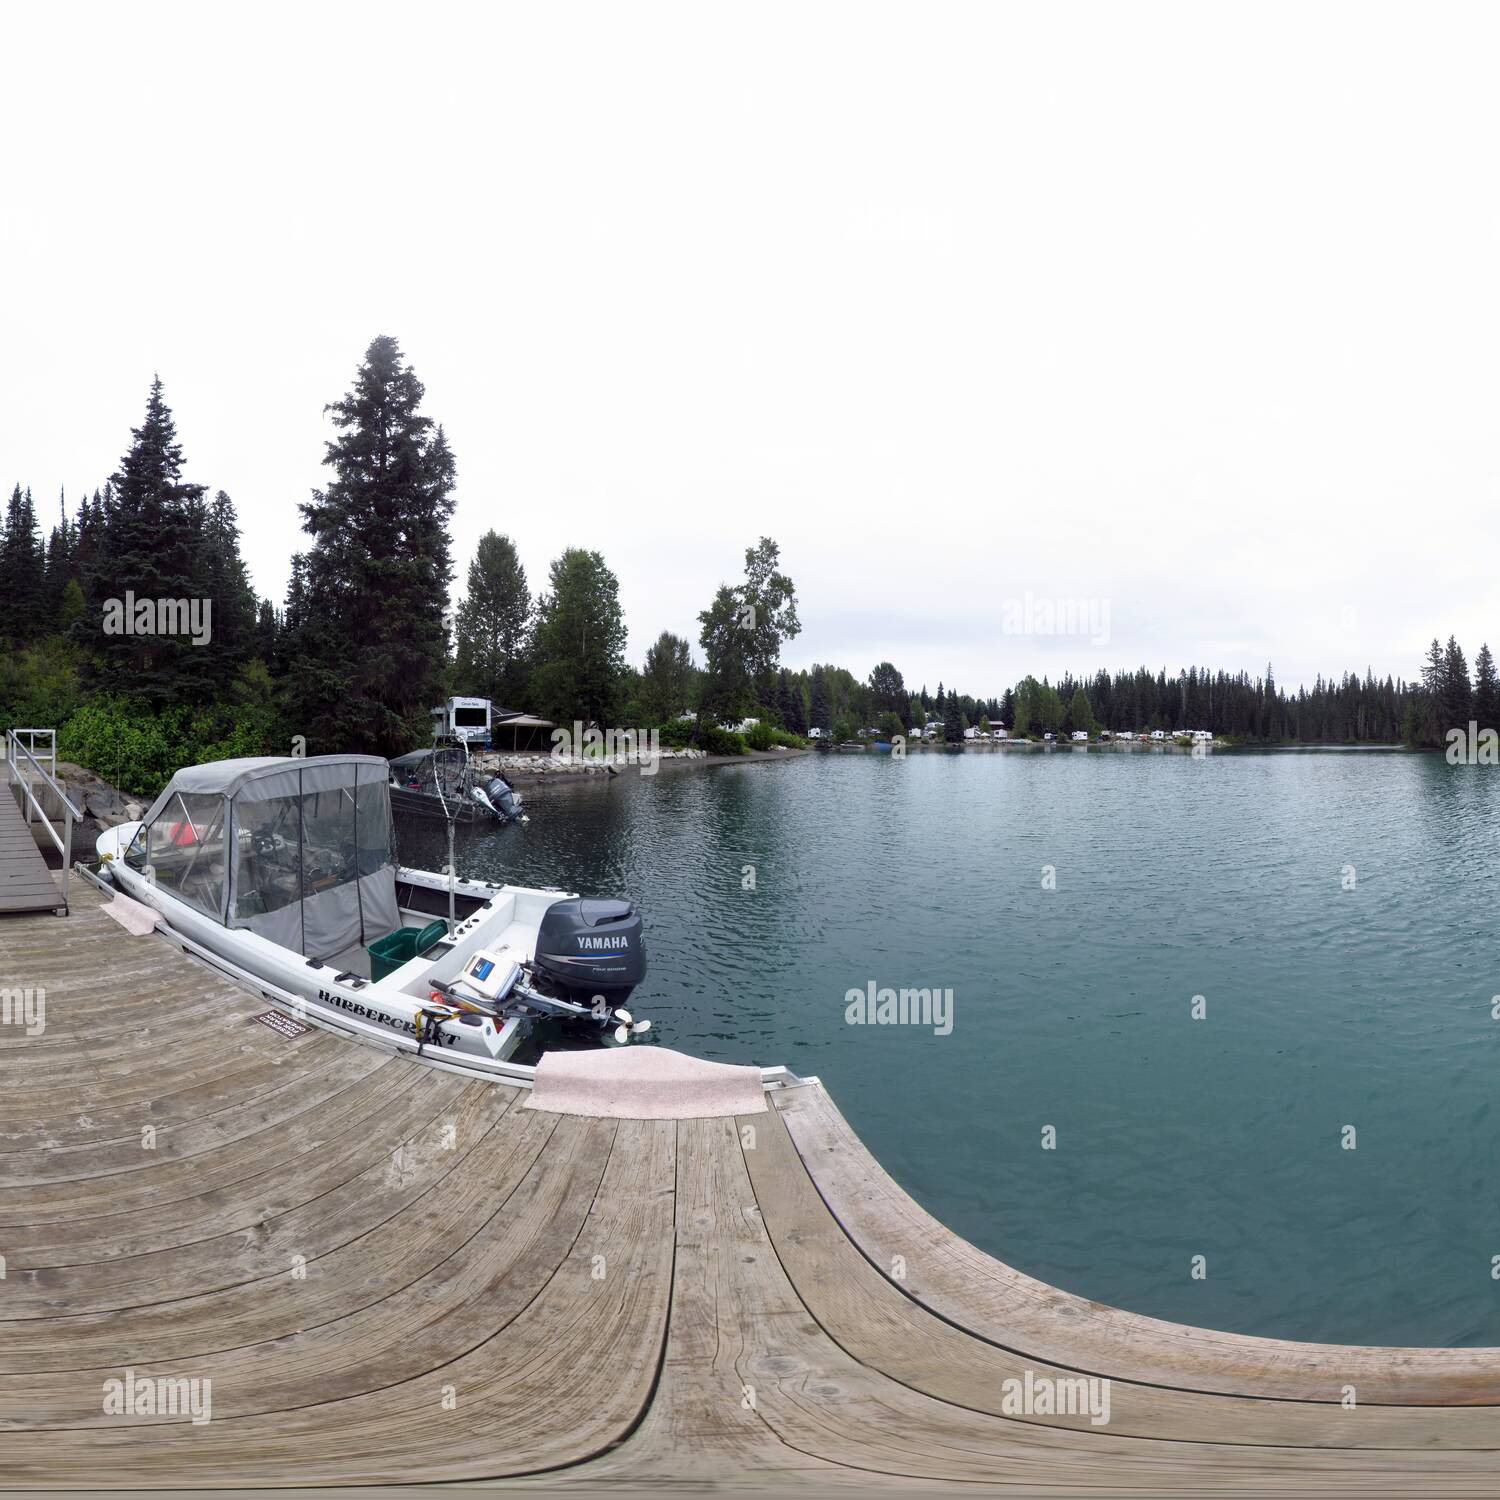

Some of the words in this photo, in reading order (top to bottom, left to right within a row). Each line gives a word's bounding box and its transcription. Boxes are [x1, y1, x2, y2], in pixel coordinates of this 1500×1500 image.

[577, 936, 628, 949] YAMAHA
[265, 1014, 285, 1025] PARK
[270, 1011, 306, 1031] OPERATOR
[260, 1017, 295, 1037] RESERVED
[283, 1023, 299, 1033] FOR
